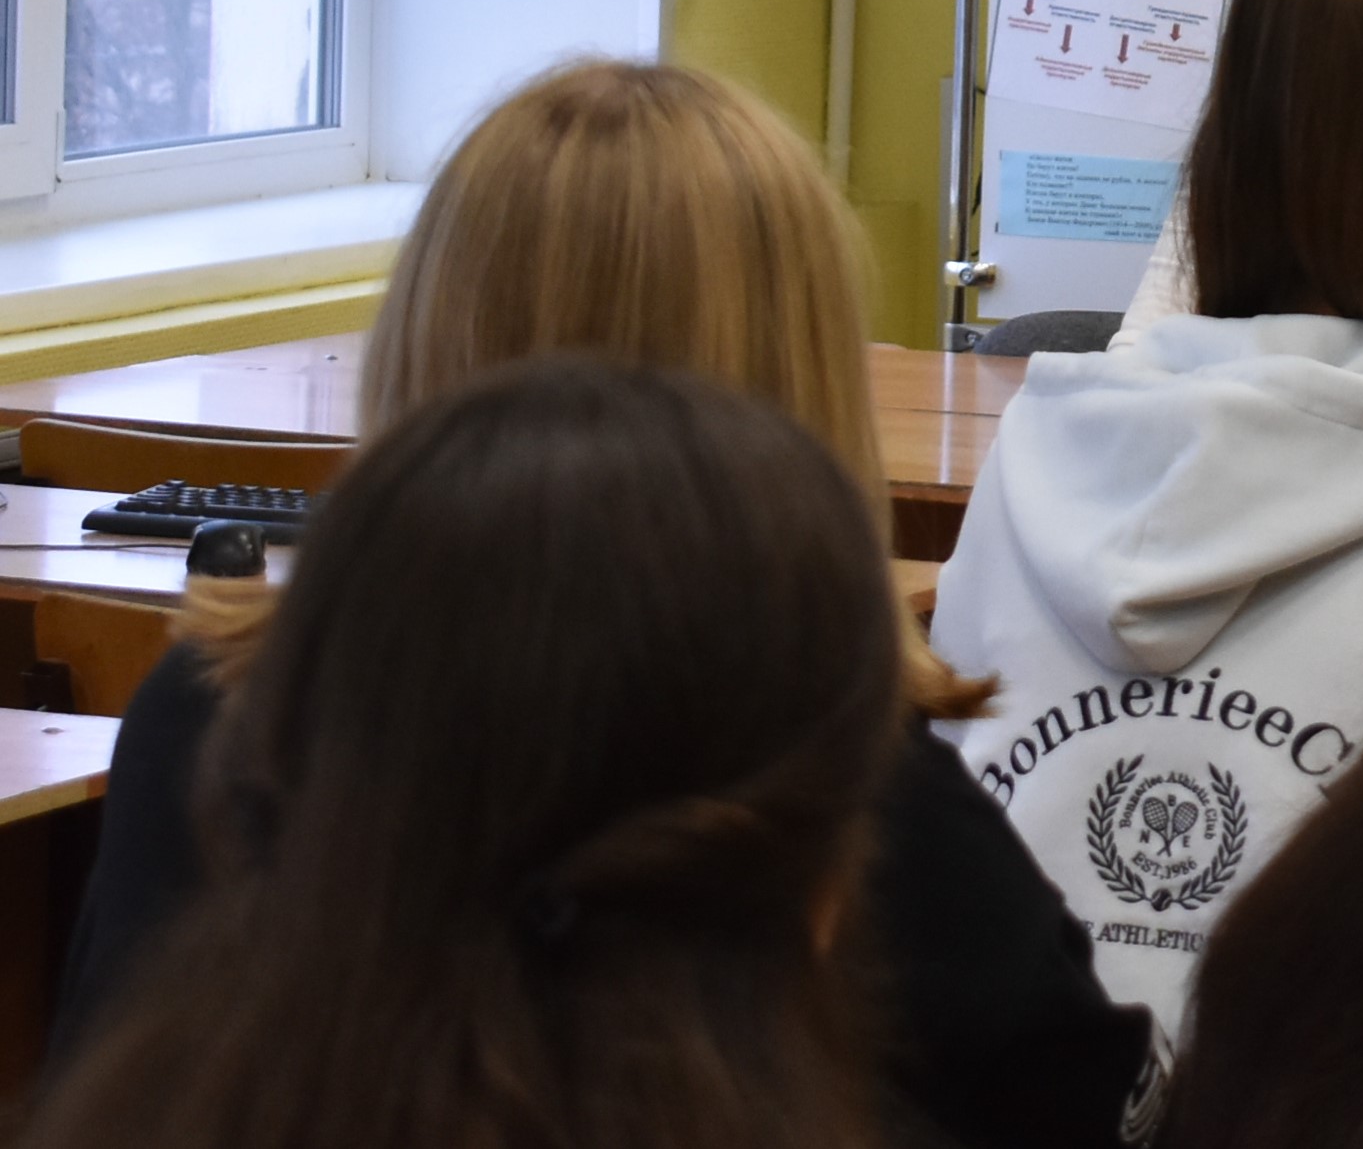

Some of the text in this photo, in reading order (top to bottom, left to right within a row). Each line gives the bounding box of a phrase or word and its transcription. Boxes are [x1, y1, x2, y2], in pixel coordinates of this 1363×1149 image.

[1166, 771, 1210, 807] Athletic
[1204, 808, 1218, 840] Club
[1139, 829, 1150, 844] N
[1182, 835, 1191, 848] E
